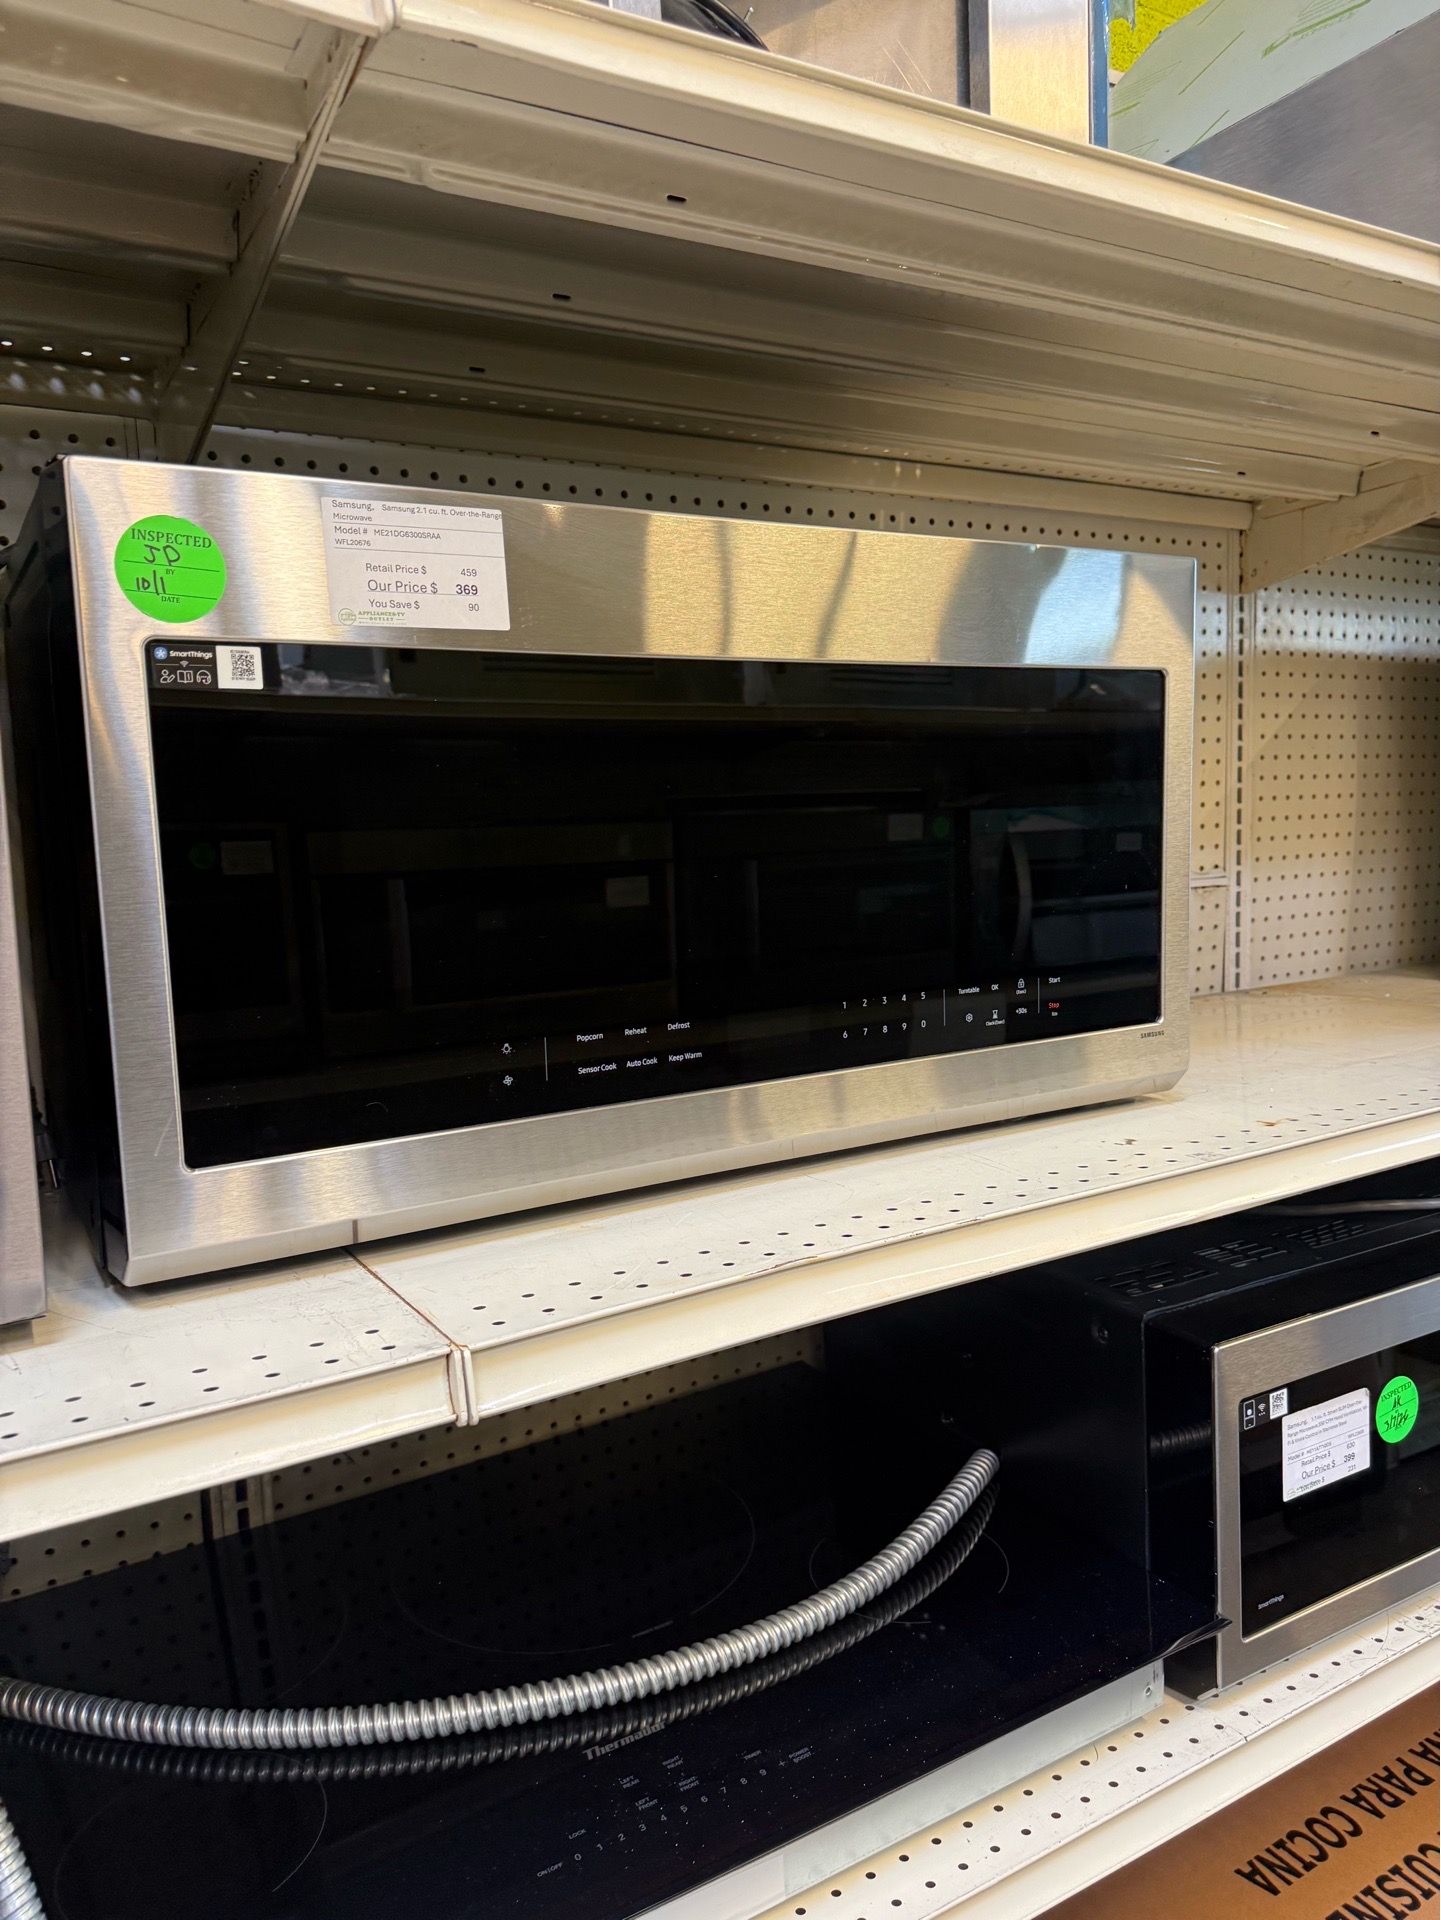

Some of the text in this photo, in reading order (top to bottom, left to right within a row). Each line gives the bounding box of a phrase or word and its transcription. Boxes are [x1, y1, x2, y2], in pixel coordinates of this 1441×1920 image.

[332, 500, 375, 511] Samsung,
[382, 504, 416, 514] Samsung
[333, 512, 373, 522] Microwave
[334, 525, 361, 535] Model
[131, 528, 212, 549] INSPECTED
[365, 562, 477, 577] Retail Price $ 459
[367, 579, 478, 595] Our Price $ 369
[369, 598, 480, 612] You Save $ 90
[170, 650, 213, 660] SmartThings
[958, 986, 980, 995] Turntable
[624, 1027, 647, 1036] Reheat
[667, 1022, 691, 1030] Defrost
[576, 1033, 604, 1042] Popcorn
[626, 1057, 658, 1068] Auto Cook
[668, 1051, 703, 1062] Keep Warm
[578, 1062, 617, 1075] Sensor Cook
[1381, 1381, 1412, 1401] INSPECTED
[1301, 1452, 1356, 1480] Our Price $ 399
[582, 1721, 666, 1760] Thermador
[1340, 1756, 1436, 1819] PARA
[635, 1796, 650, 1807] LEFT
[568, 1828, 587, 1840] LOCK
[1234, 1806, 1363, 1896] COCINA
